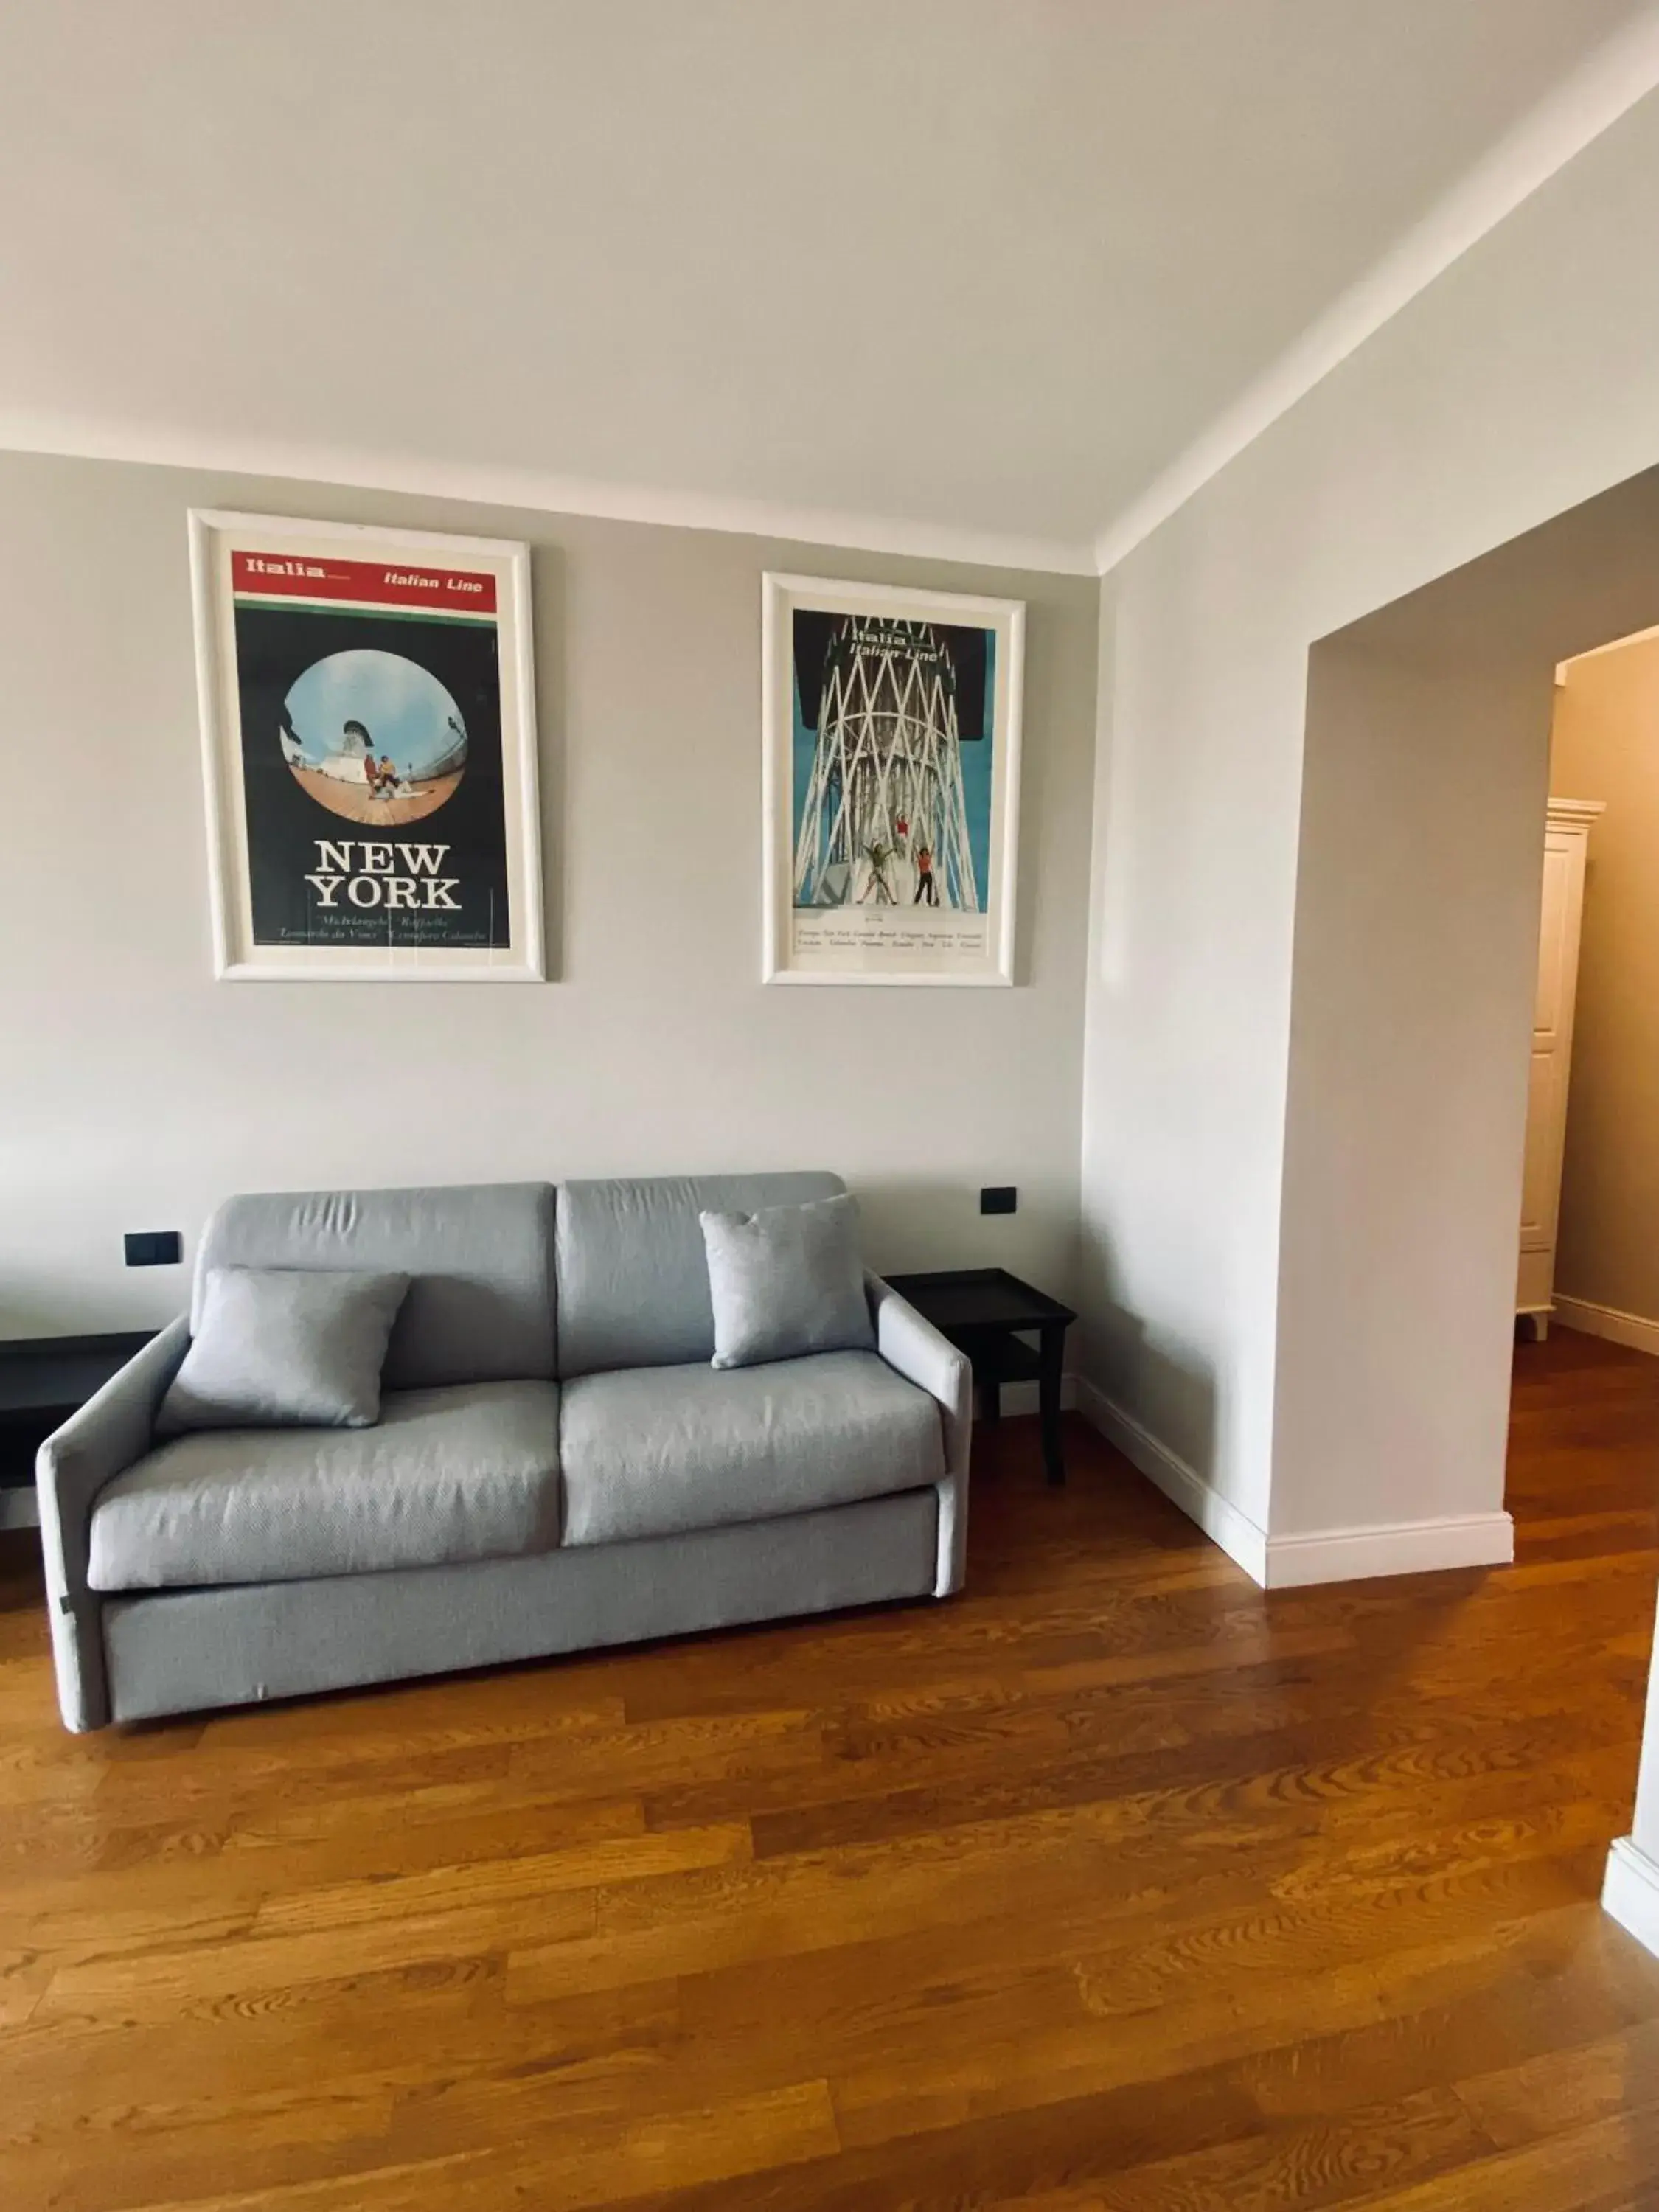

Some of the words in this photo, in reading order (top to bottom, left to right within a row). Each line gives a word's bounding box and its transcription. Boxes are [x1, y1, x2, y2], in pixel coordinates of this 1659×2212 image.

[246, 558, 327, 579] Italia
[383, 571, 439, 589] Italian
[447, 577, 484, 594] Line
[313, 839, 451, 875] NEW
[304, 874, 463, 910] YORK
